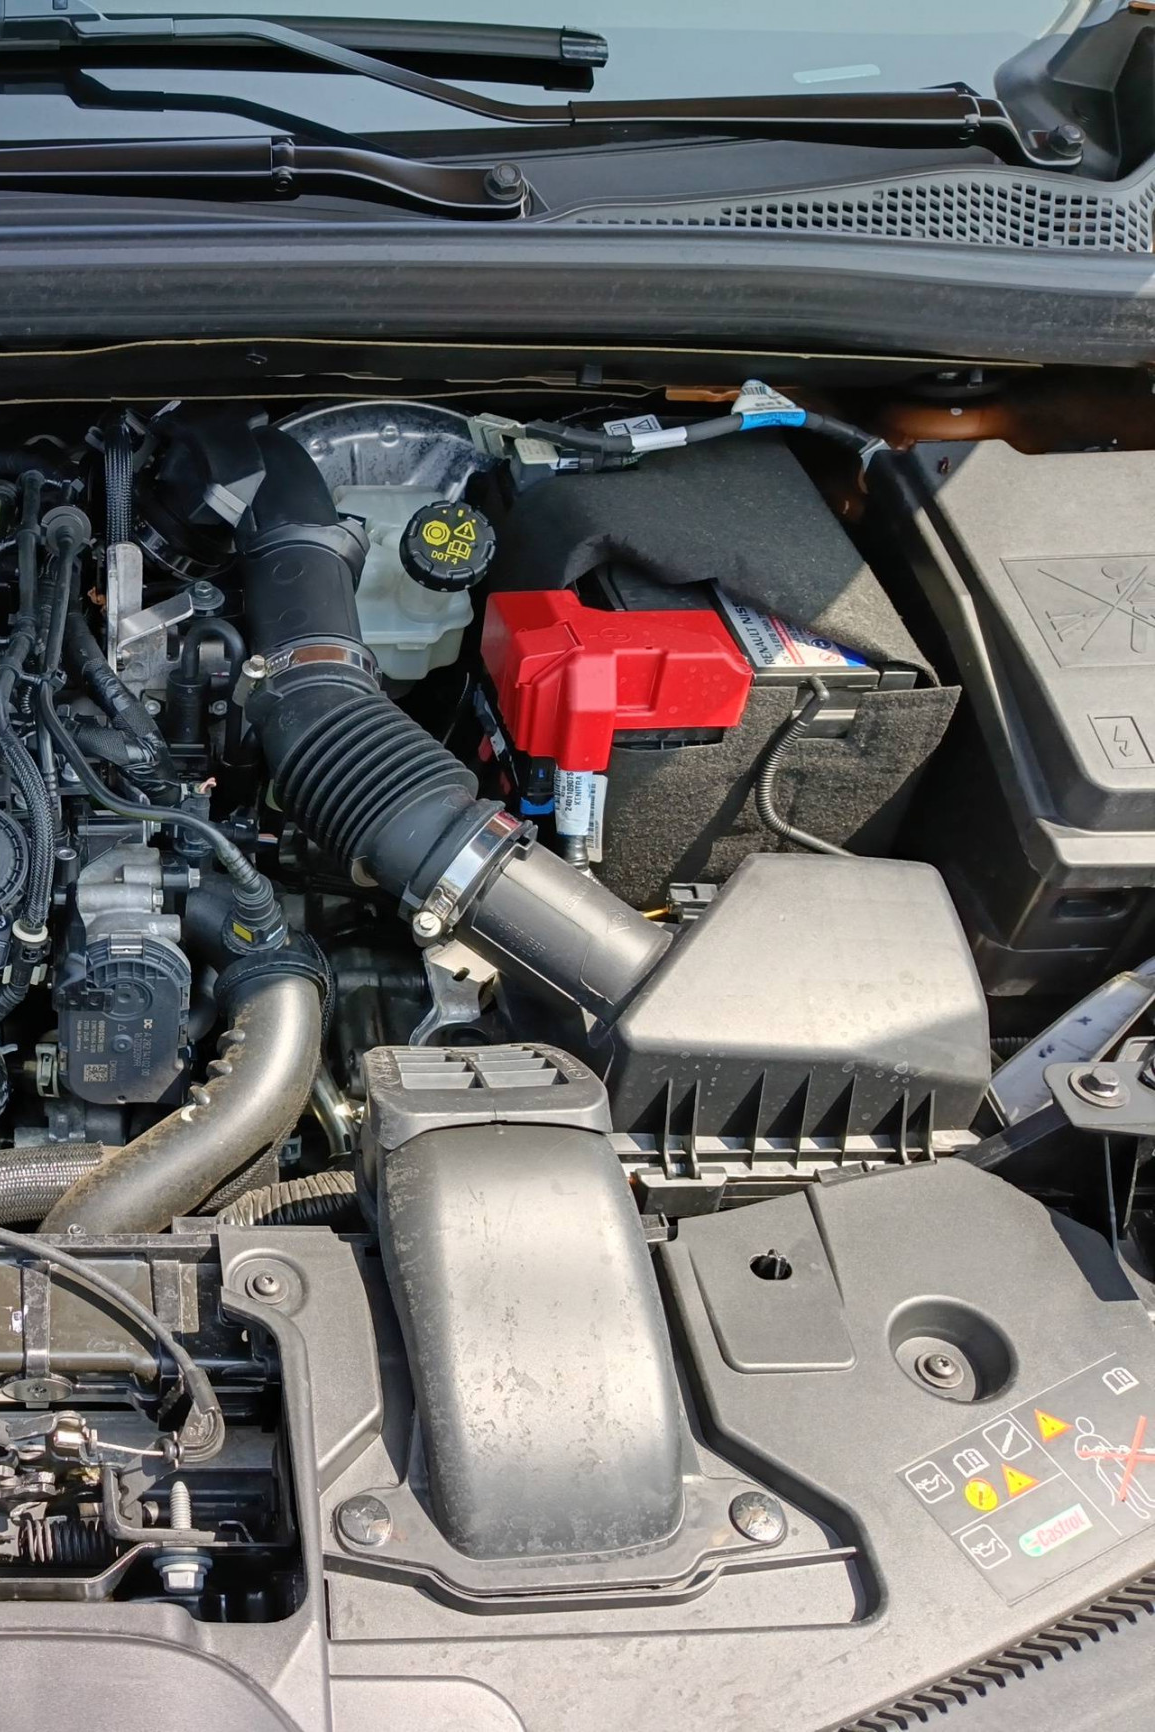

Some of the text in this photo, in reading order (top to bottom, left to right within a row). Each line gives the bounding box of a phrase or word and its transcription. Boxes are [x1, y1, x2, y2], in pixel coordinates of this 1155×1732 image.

[431, 550, 458, 565] DOT 4
[746, 626, 776, 665] RENAULT
[144, 1019, 153, 1029] DC
[1036, 1510, 1085, 1547] Castrol
